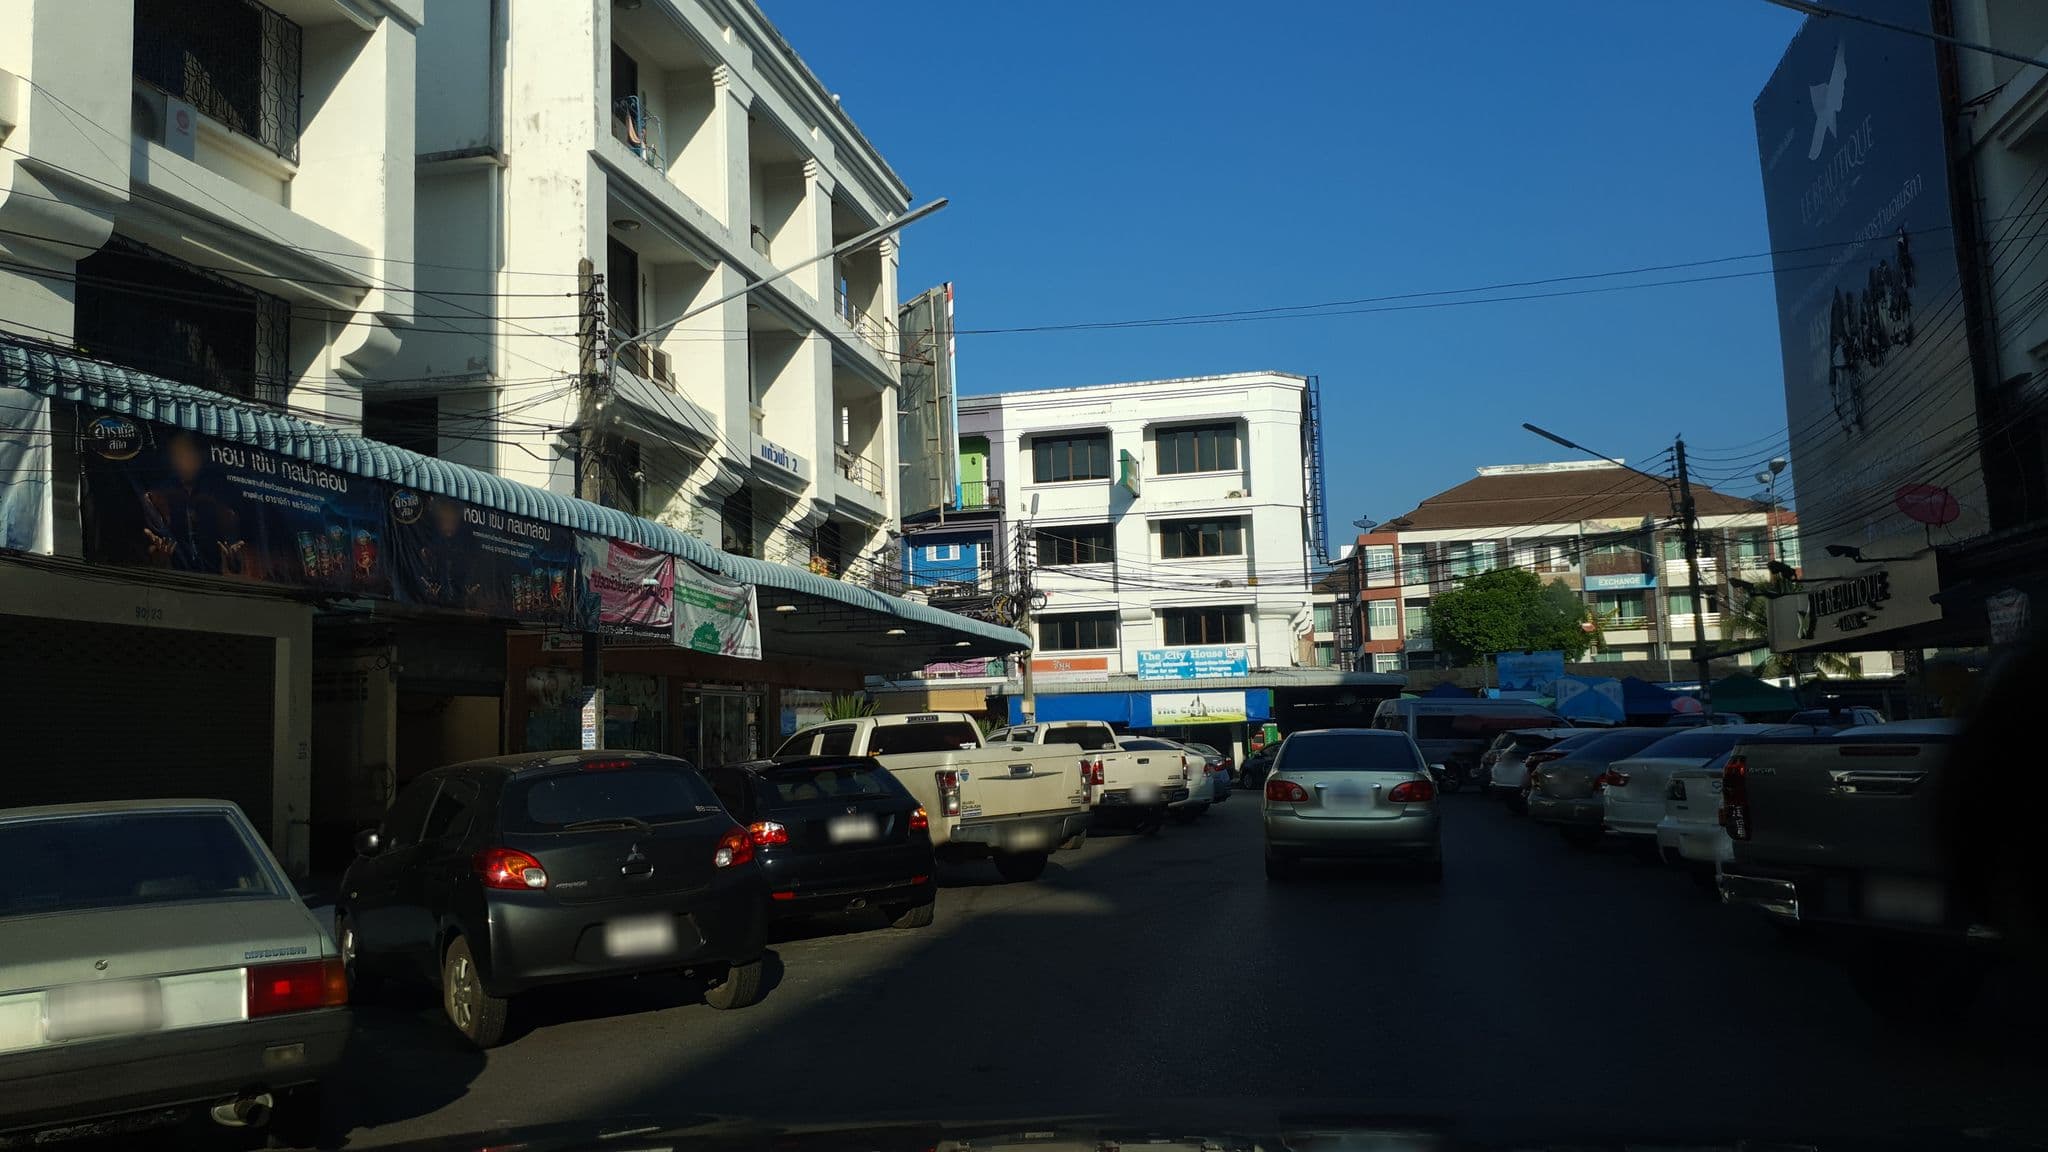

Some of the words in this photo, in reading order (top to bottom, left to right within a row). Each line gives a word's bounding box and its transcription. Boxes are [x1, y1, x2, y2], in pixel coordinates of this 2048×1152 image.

[210, 443, 245, 468] หอม
[281, 461, 348, 493] กลมกล่อม
[761, 443, 789, 468] แก้วฟ้า
[792, 458, 798, 472] 2
[463, 508, 486, 525] หอม
[507, 518, 551, 541] กลมกล่อม
[1598, 576, 1641, 586] EXCHANGE
[1824, 571, 1884, 614] BEAUTIQUE
[1141, 651, 1161, 661] The
[1164, 651, 1186, 662] City
[1190, 649, 1223, 659] House
[1157, 706, 1176, 715] The
[1207, 704, 1242, 713] House
